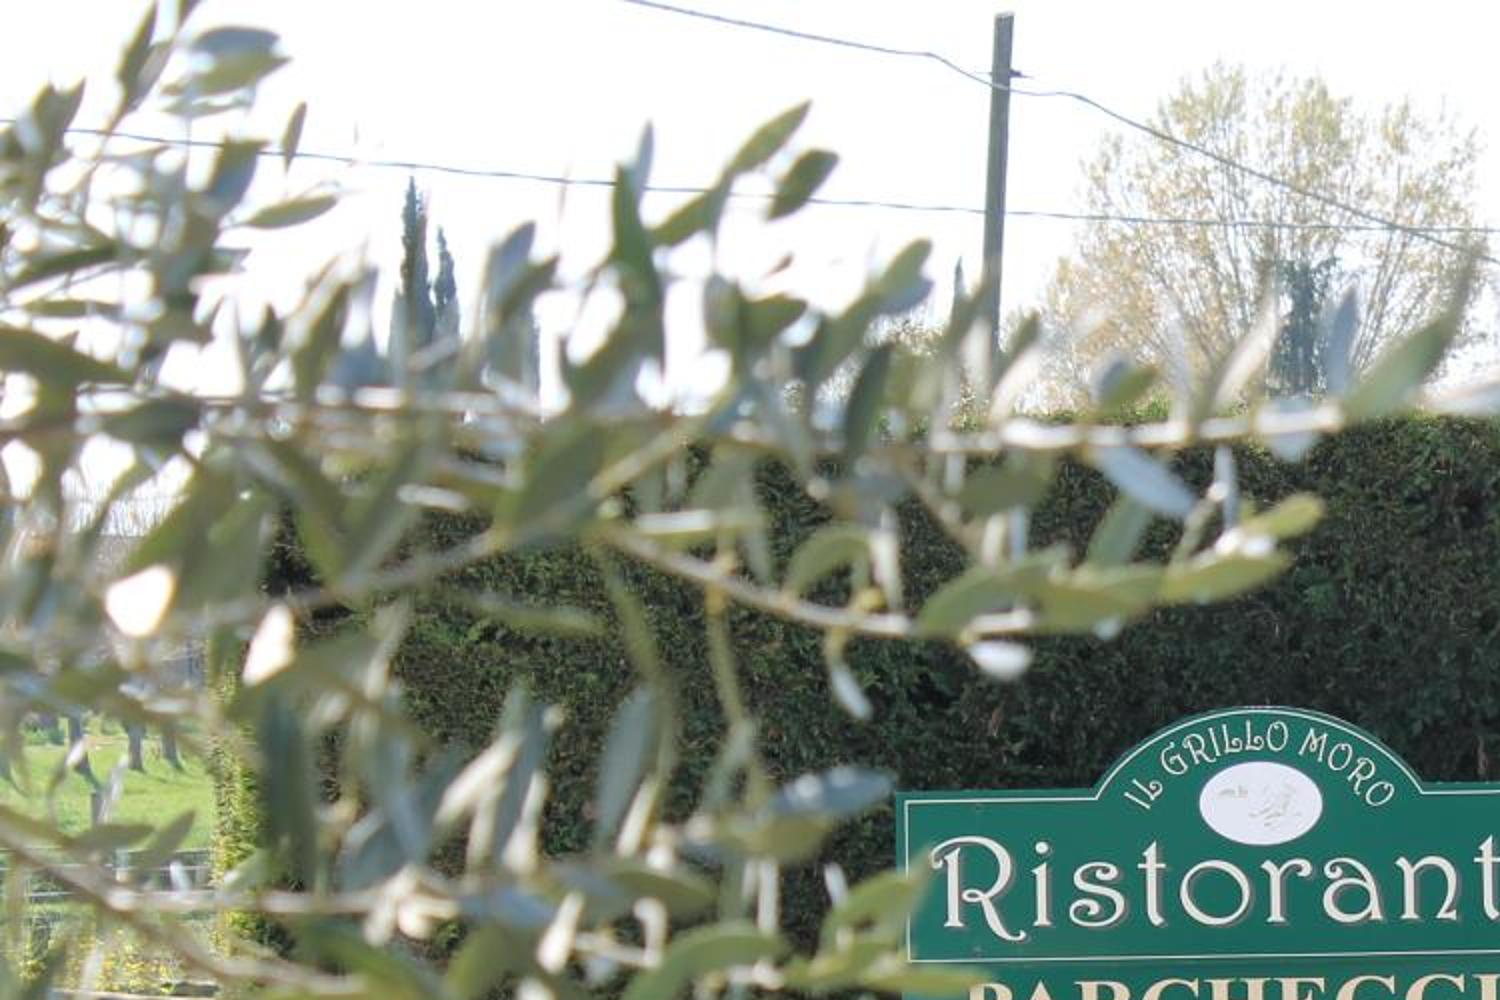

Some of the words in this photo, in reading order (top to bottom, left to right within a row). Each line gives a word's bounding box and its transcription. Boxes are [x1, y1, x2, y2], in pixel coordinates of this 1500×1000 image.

[1123, 778, 1163, 810] IL
[1160, 720, 1289, 776] GRILLO
[1298, 728, 1395, 807] MORO
